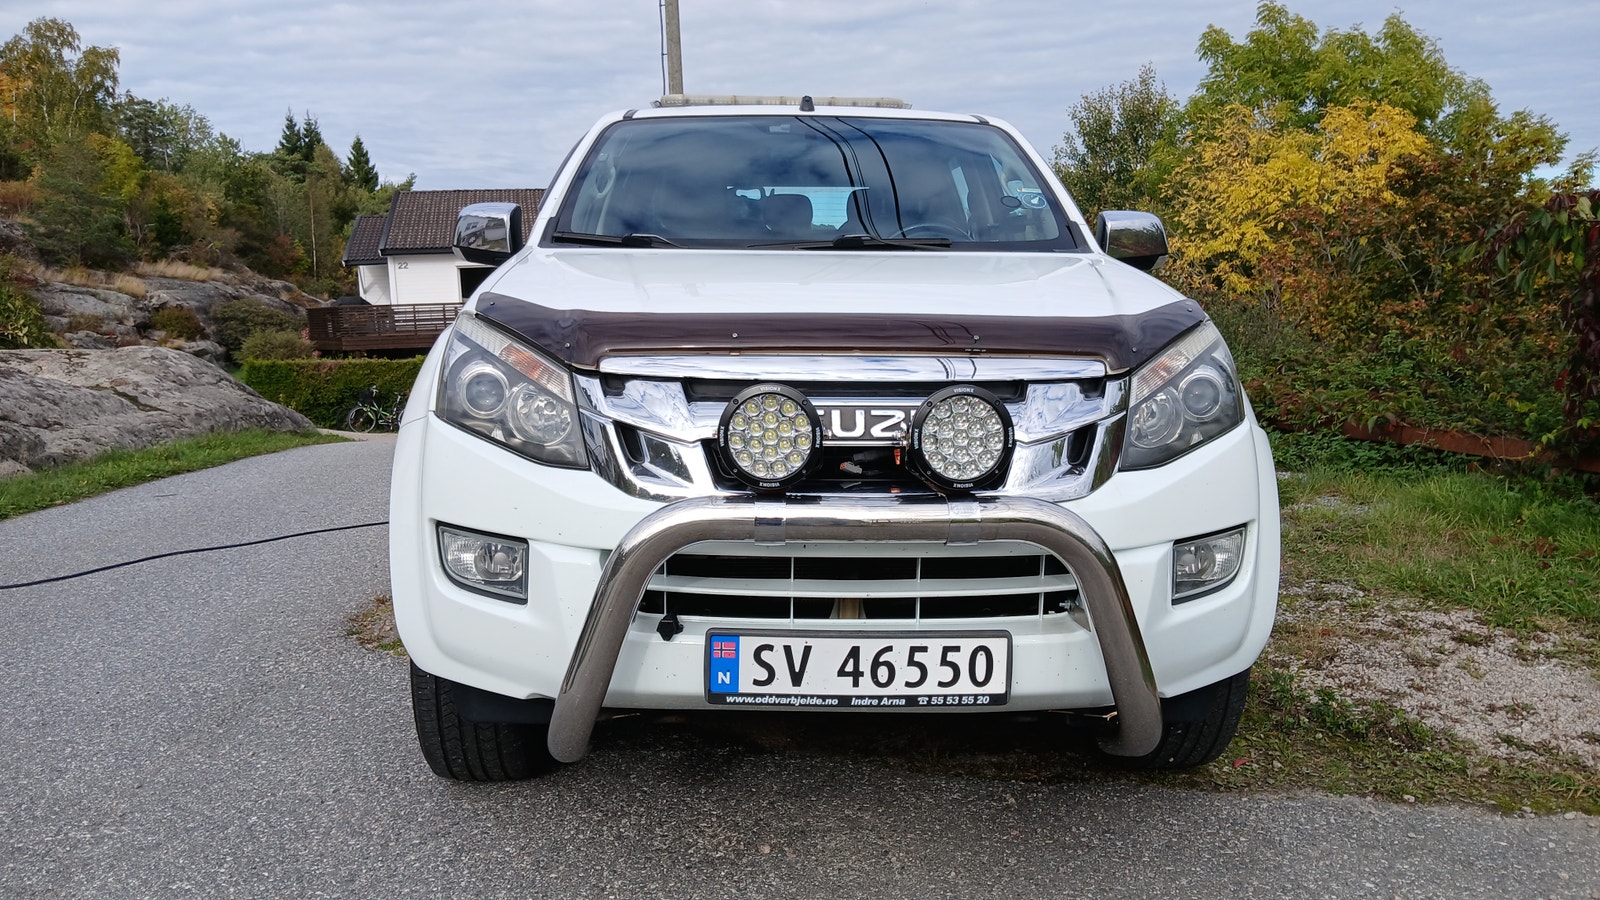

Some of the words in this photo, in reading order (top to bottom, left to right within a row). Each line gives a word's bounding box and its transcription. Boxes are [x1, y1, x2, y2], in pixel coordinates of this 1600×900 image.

[397, 261, 408, 269] 22
[816, 409, 917, 438] UZ
[752, 643, 812, 687] SV
[837, 645, 994, 688] 46550
[718, 671, 730, 684] N
[726, 694, 838, 706] www.oddvarbjelde.no
[851, 697, 878, 706] Indre
[880, 697, 906, 706] Arna
[930, 697, 944, 706] 55
[946, 696, 959, 705] 53
[961, 696, 974, 705] 55
[976, 695, 990, 705] 20
